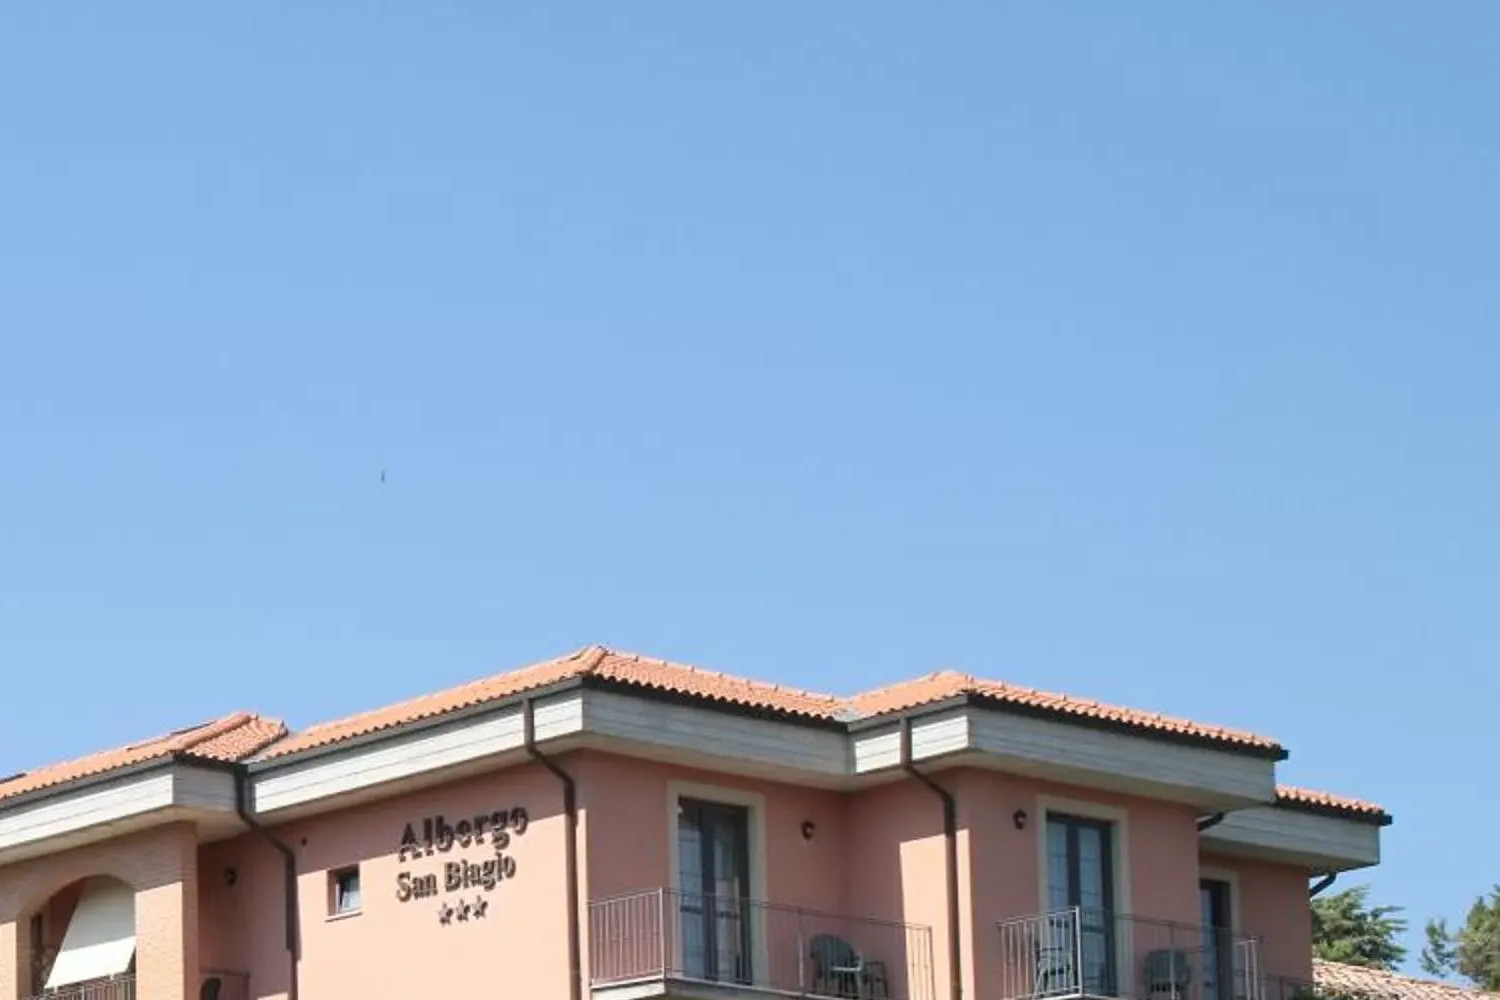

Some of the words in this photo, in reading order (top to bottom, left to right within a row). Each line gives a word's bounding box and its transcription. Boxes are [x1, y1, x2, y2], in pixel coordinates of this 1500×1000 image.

[399, 807, 528, 862] Albergo
[396, 871, 438, 902] San
[445, 852, 517, 891] Biagio
